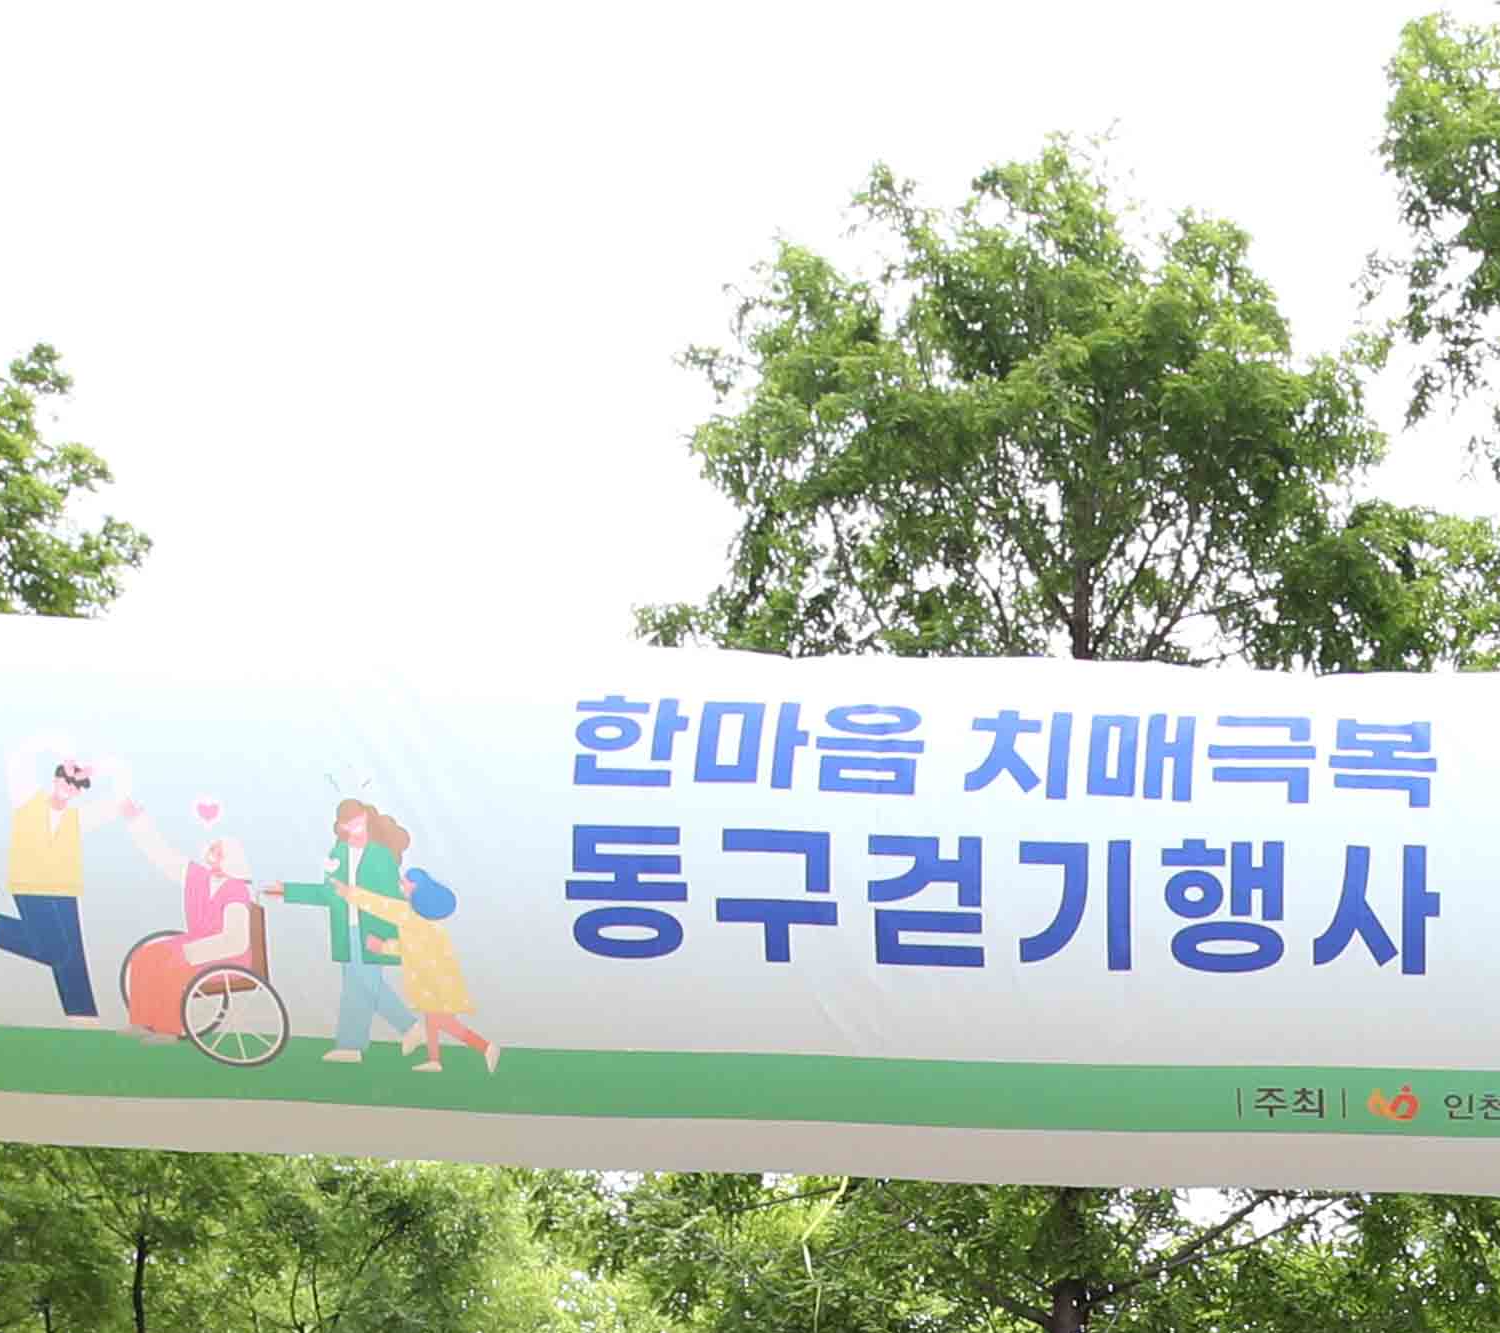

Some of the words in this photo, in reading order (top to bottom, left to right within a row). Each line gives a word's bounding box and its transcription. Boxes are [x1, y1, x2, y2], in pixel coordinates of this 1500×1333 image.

[572, 695, 925, 801] 한마음
[963, 709, 1438, 808] 치매극복
[564, 823, 1441, 976] 동구걷기행사
